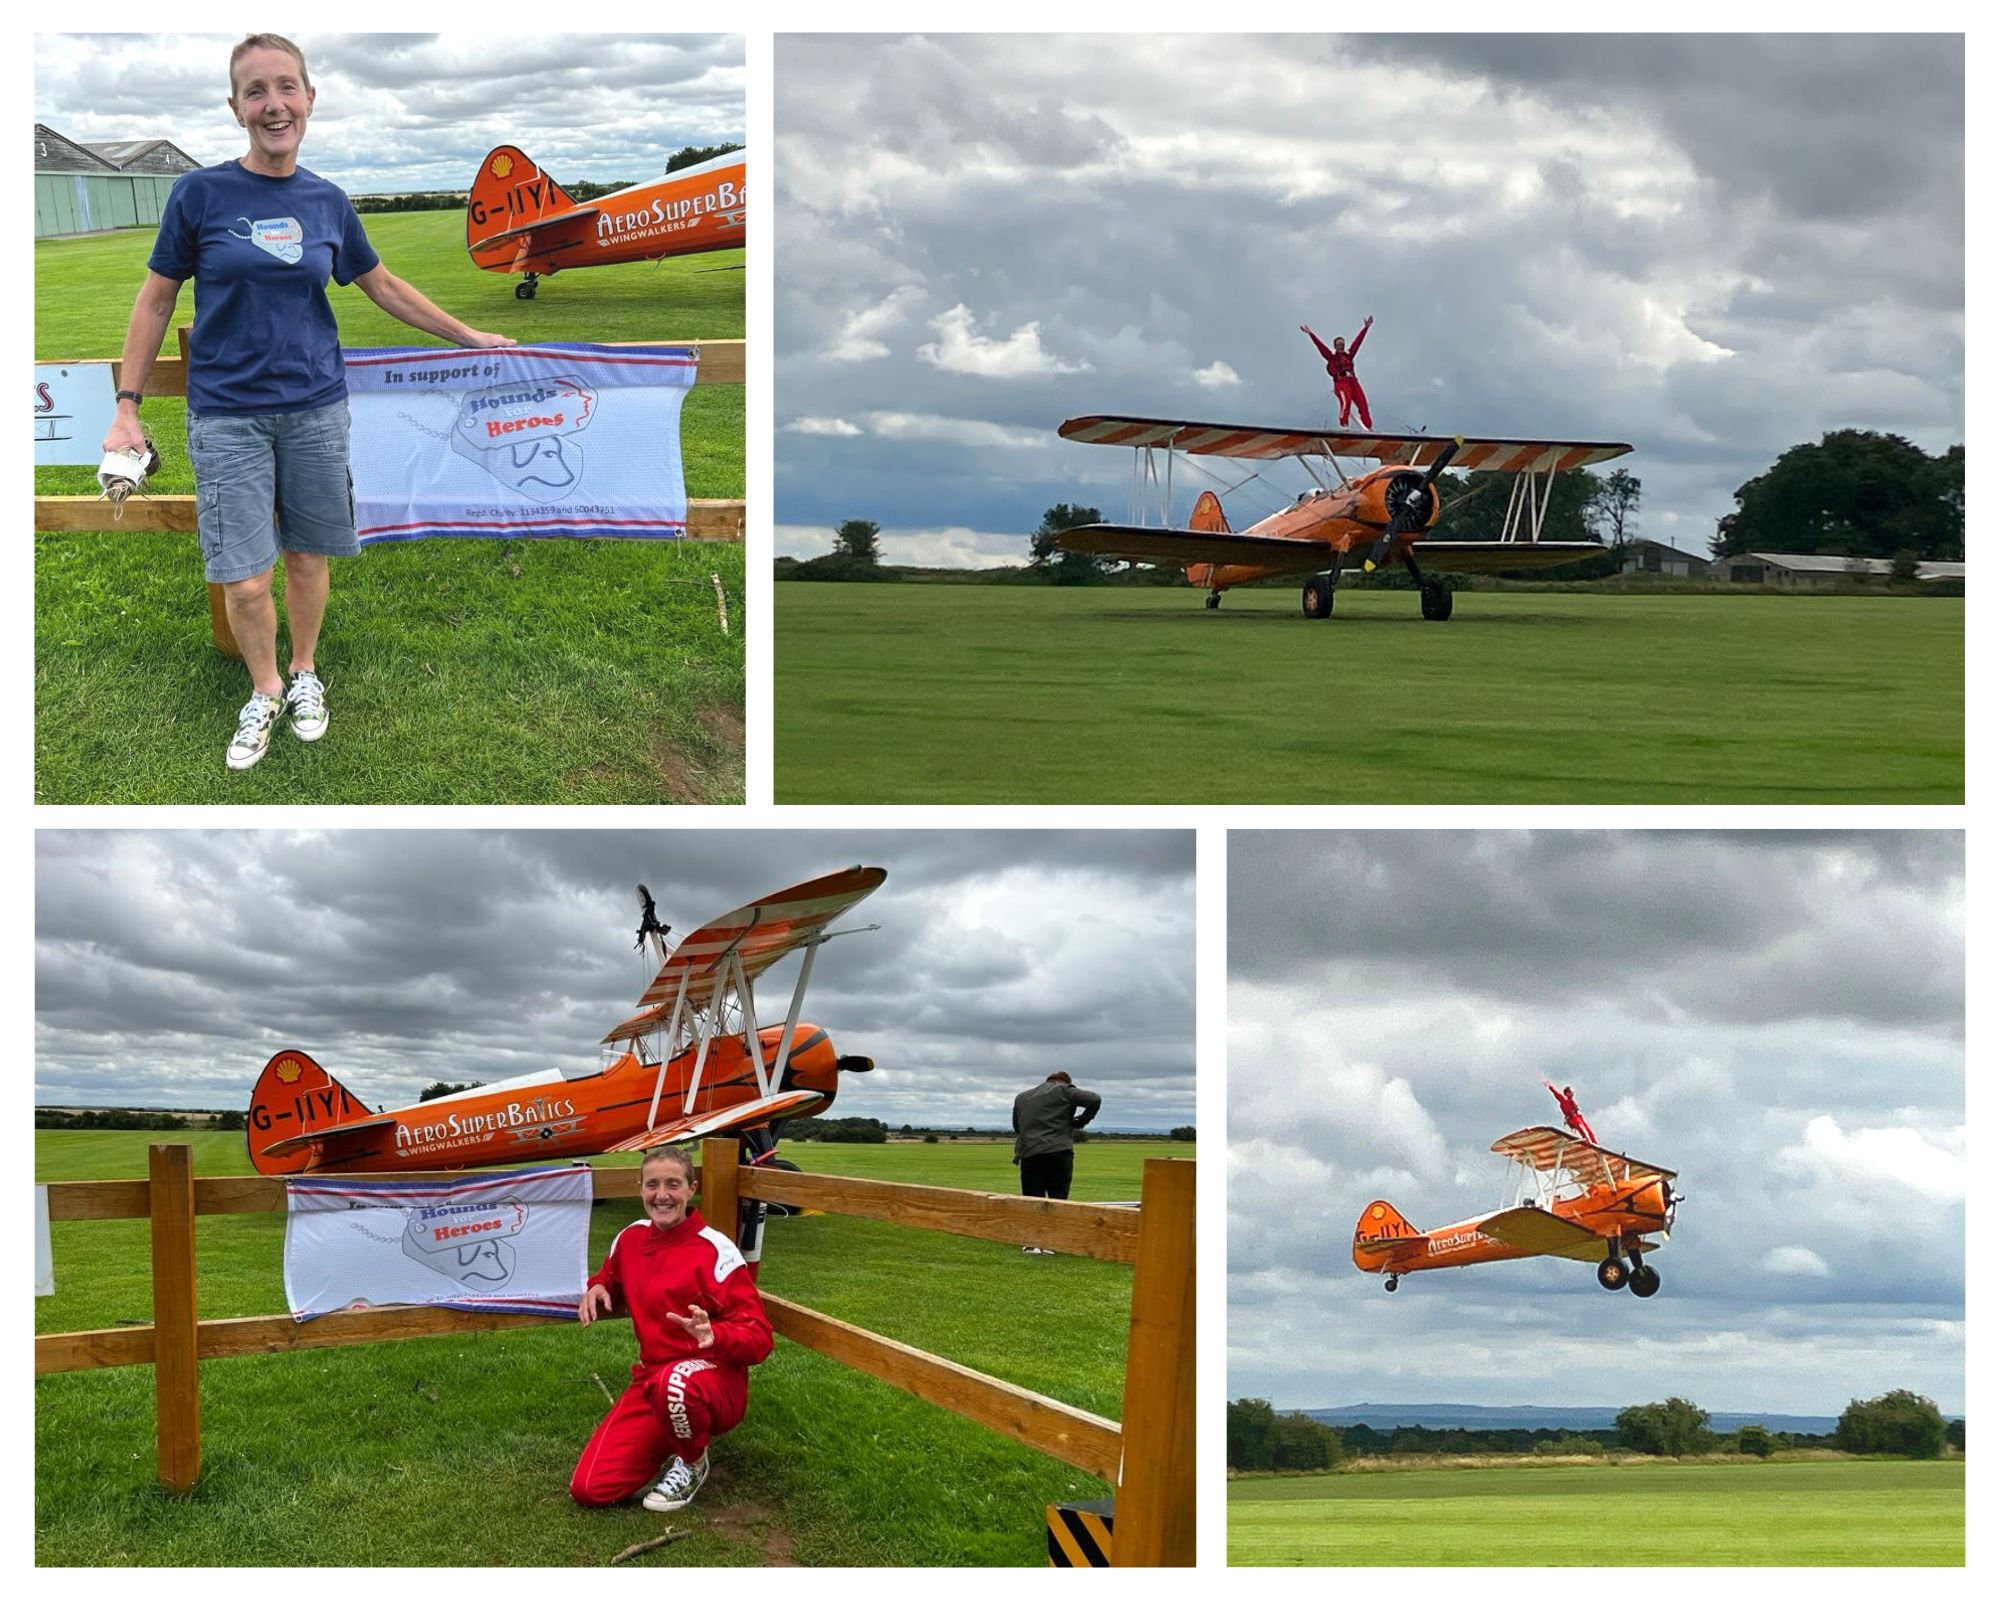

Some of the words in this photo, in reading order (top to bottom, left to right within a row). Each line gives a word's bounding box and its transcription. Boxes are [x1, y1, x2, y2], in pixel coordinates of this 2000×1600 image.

[40, 142, 48, 158] 3
[255, 221, 289, 231] Hounds
[609, 221, 686, 245] WINGWALKERS
[384, 370, 403, 384] In
[408, 364, 478, 384] support
[484, 363, 501, 379] of
[470, 388, 558, 415] Hounds
[486, 412, 565, 438] Heroes
[557, 505, 572, 515] and
[408, 1135, 482, 1156] WINGWALKERS
[433, 1218, 502, 1242] Heroes
